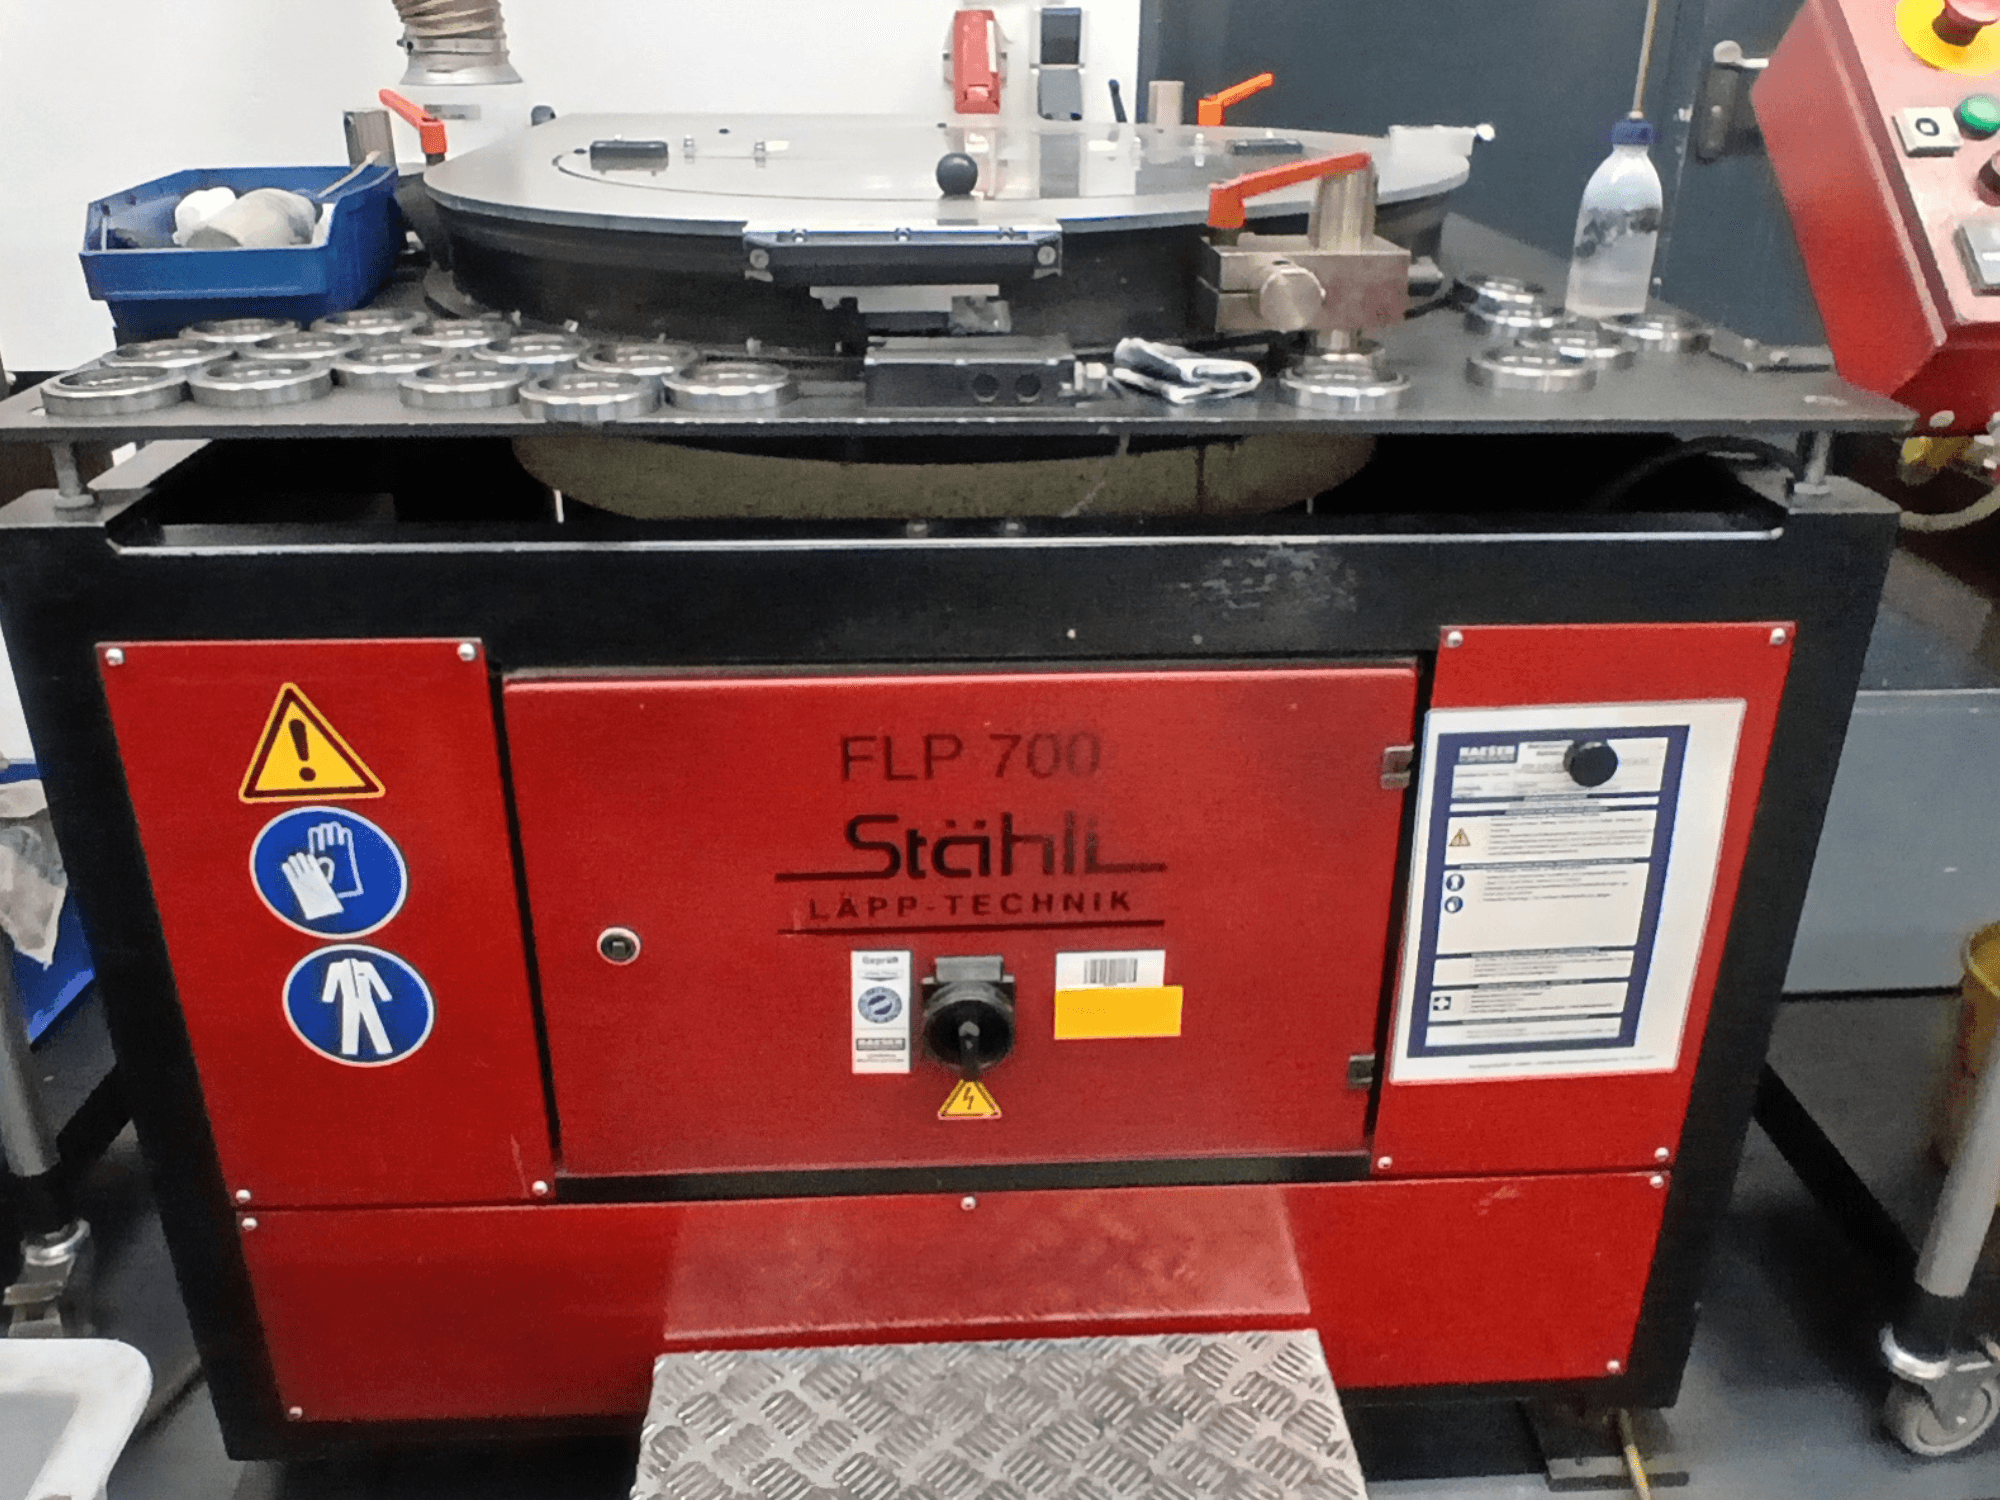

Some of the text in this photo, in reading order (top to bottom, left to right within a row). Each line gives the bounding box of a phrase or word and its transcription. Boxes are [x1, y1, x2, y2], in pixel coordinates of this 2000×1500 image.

[840, 731, 1100, 781] FLP 700
[809, 890, 1131, 921] LÄPP-TECHNIK
